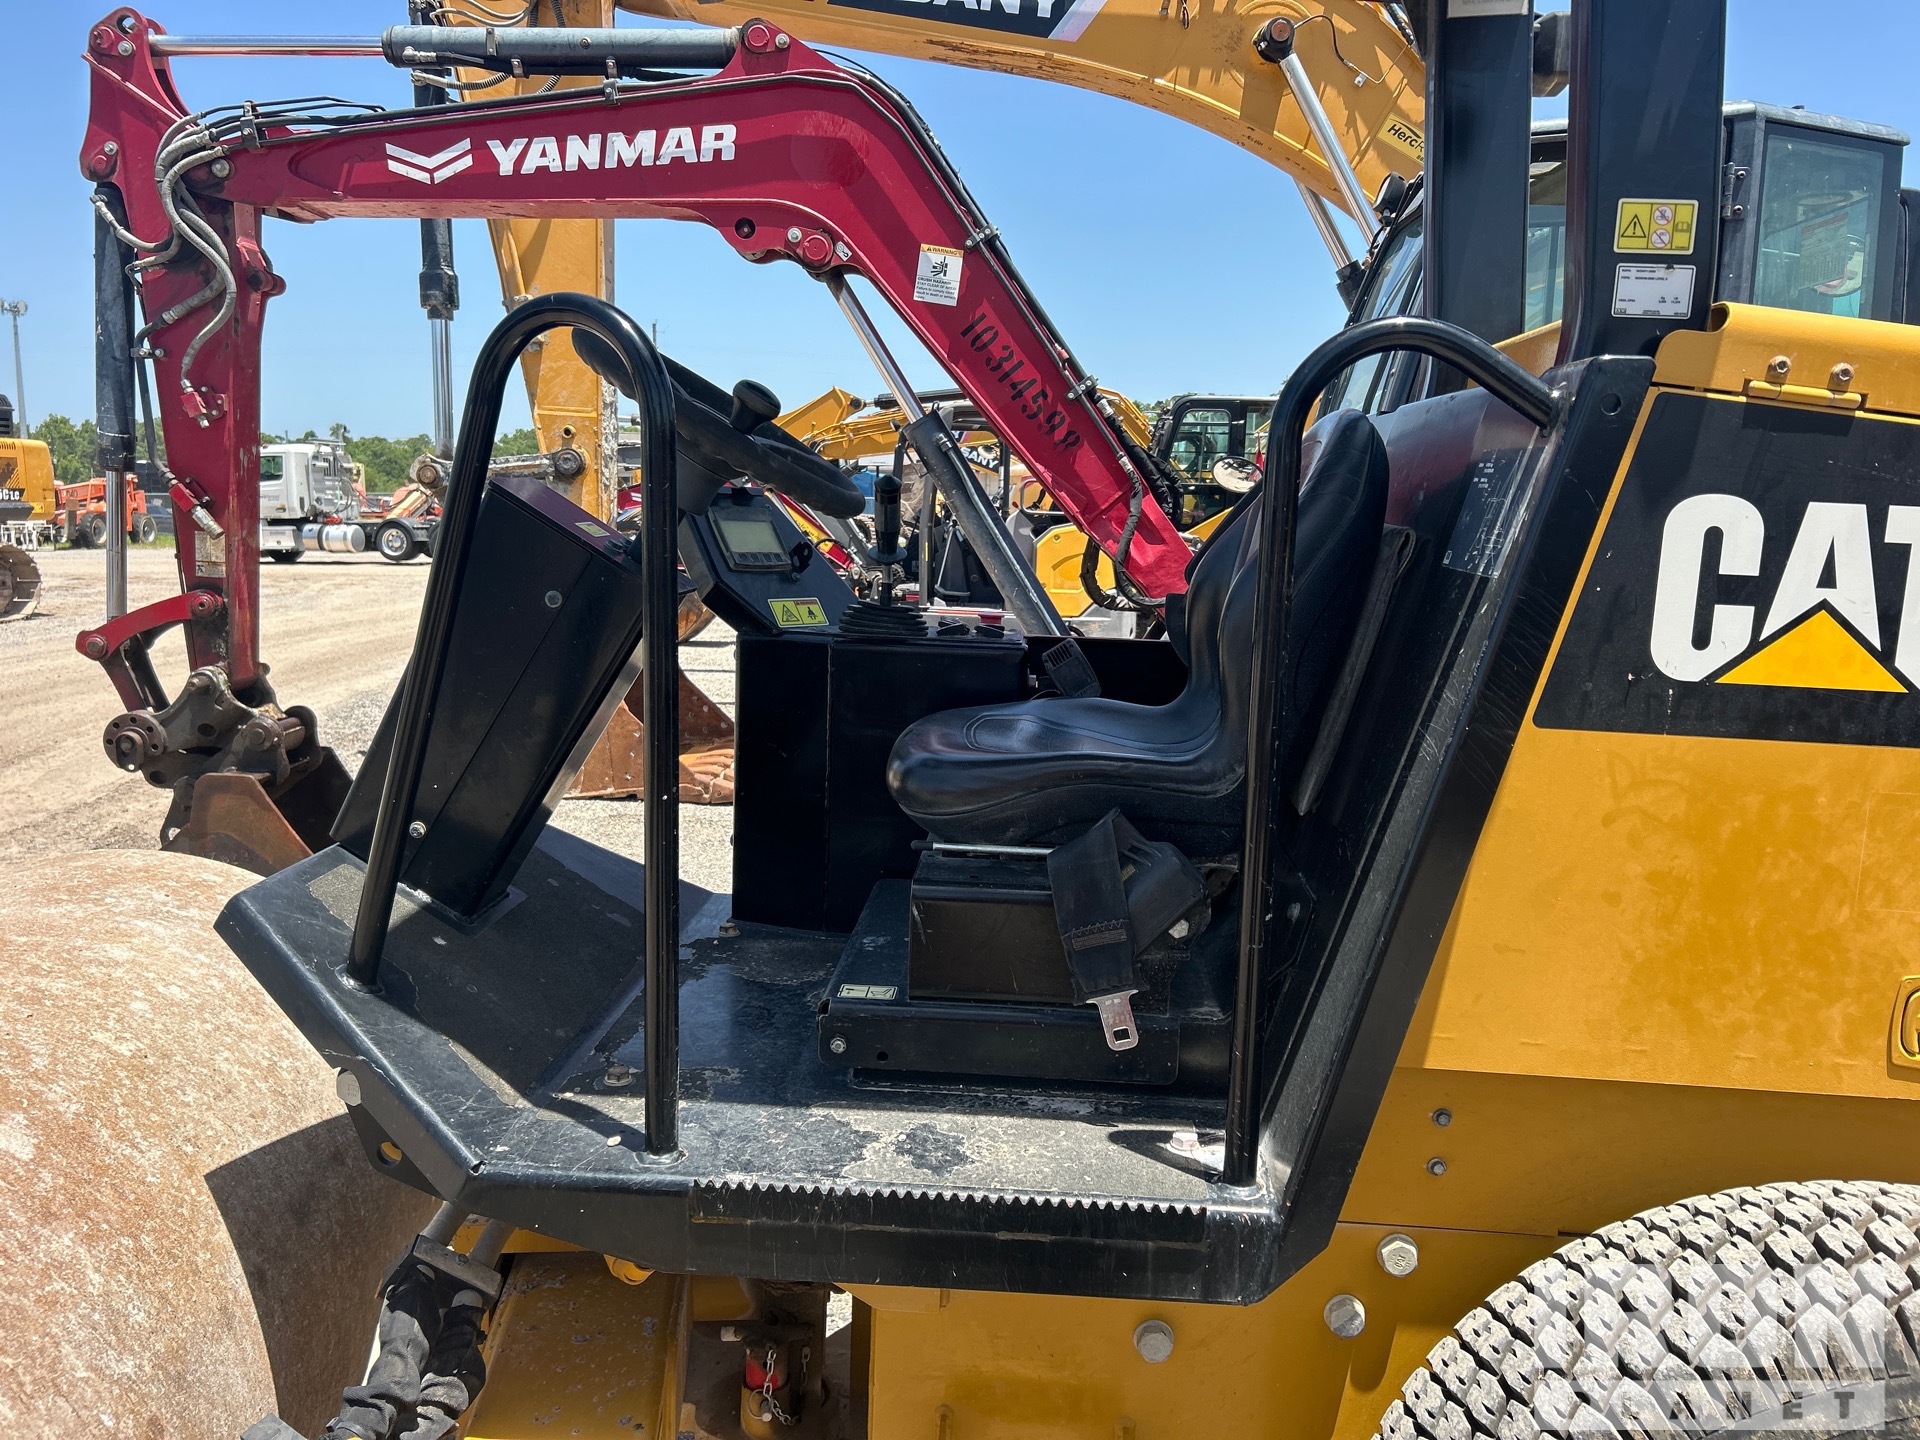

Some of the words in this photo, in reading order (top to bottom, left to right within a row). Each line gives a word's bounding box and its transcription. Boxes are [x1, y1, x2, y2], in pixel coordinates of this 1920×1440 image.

[486, 124, 737, 177] YANMAR
[932, 247, 958, 255] WARNING
[960, 312, 1081, 450] 10314598
[960, 446, 1000, 469] SANY
